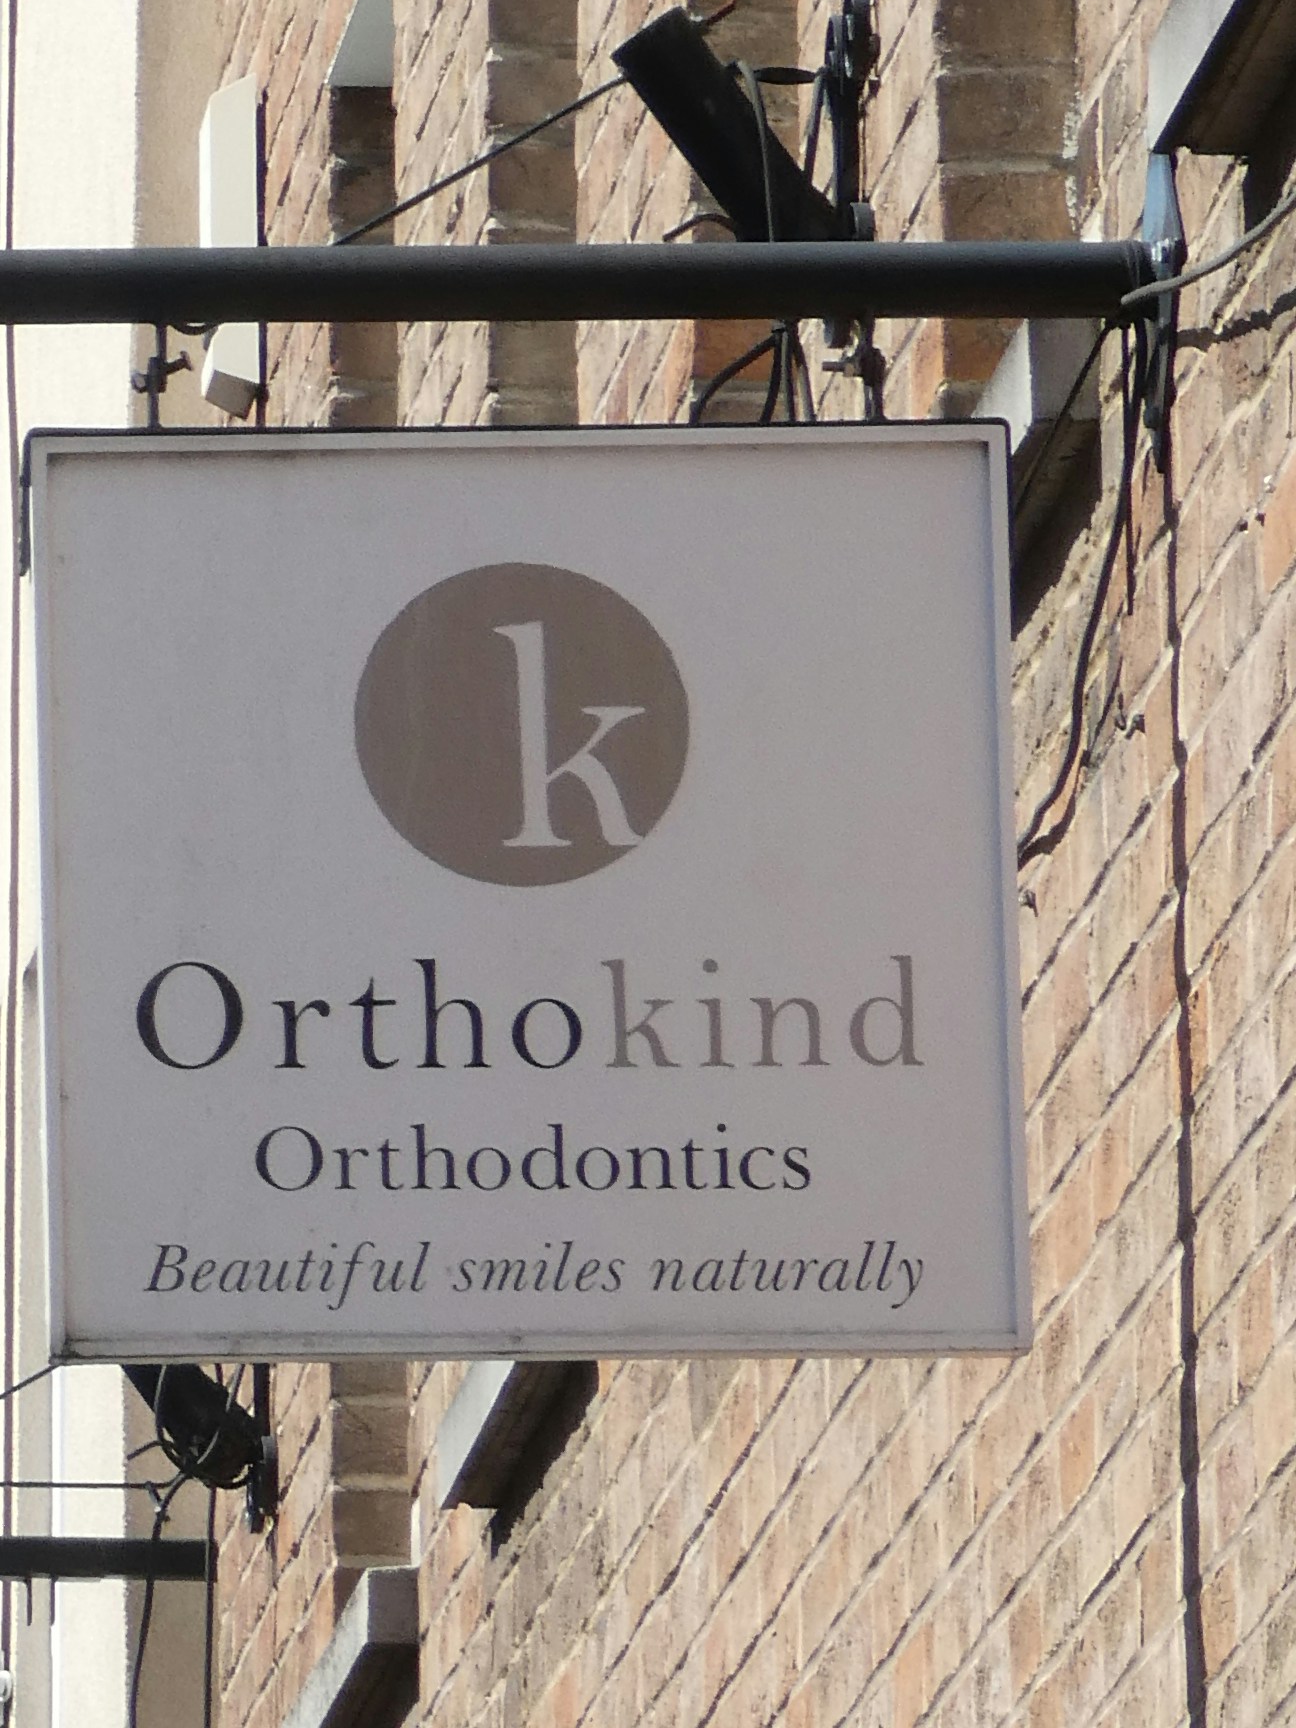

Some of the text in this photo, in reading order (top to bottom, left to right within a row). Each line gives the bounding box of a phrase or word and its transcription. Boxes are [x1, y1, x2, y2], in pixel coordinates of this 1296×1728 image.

[494, 621, 646, 849] k
[135, 955, 925, 1071] Orthokind
[254, 1123, 812, 1193] Orthodontics
[144, 1239, 924, 1312] Beautiful smiles naturally
